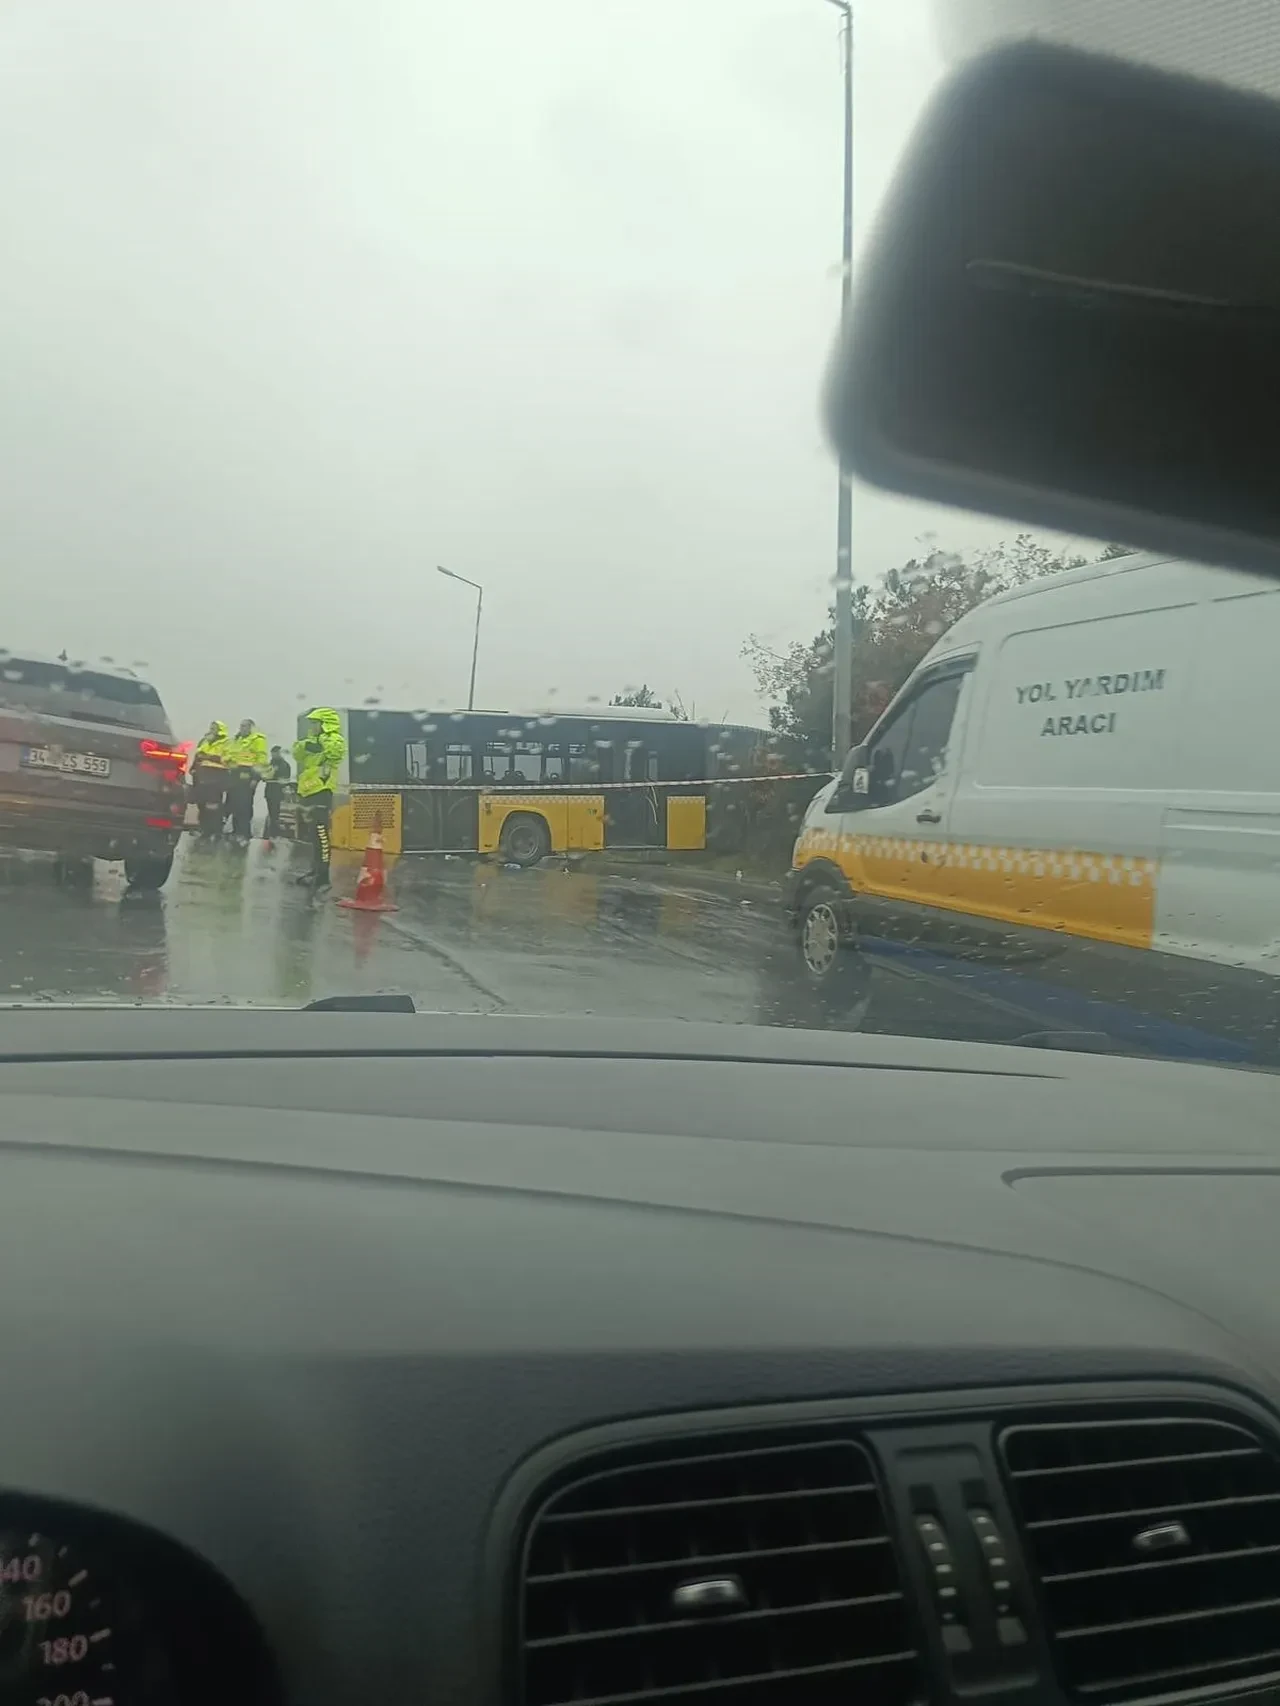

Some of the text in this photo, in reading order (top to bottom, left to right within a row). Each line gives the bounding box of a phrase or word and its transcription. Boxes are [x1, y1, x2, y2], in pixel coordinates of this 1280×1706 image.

[1016, 669, 1167, 705] YOL YARDIM
[1040, 712, 1117, 737] ARACI
[30, 749, 45, 763] 34
[83, 756, 107, 772] 559
[22, 1589, 72, 1622] 160
[38, 1634, 88, 1665] 180
